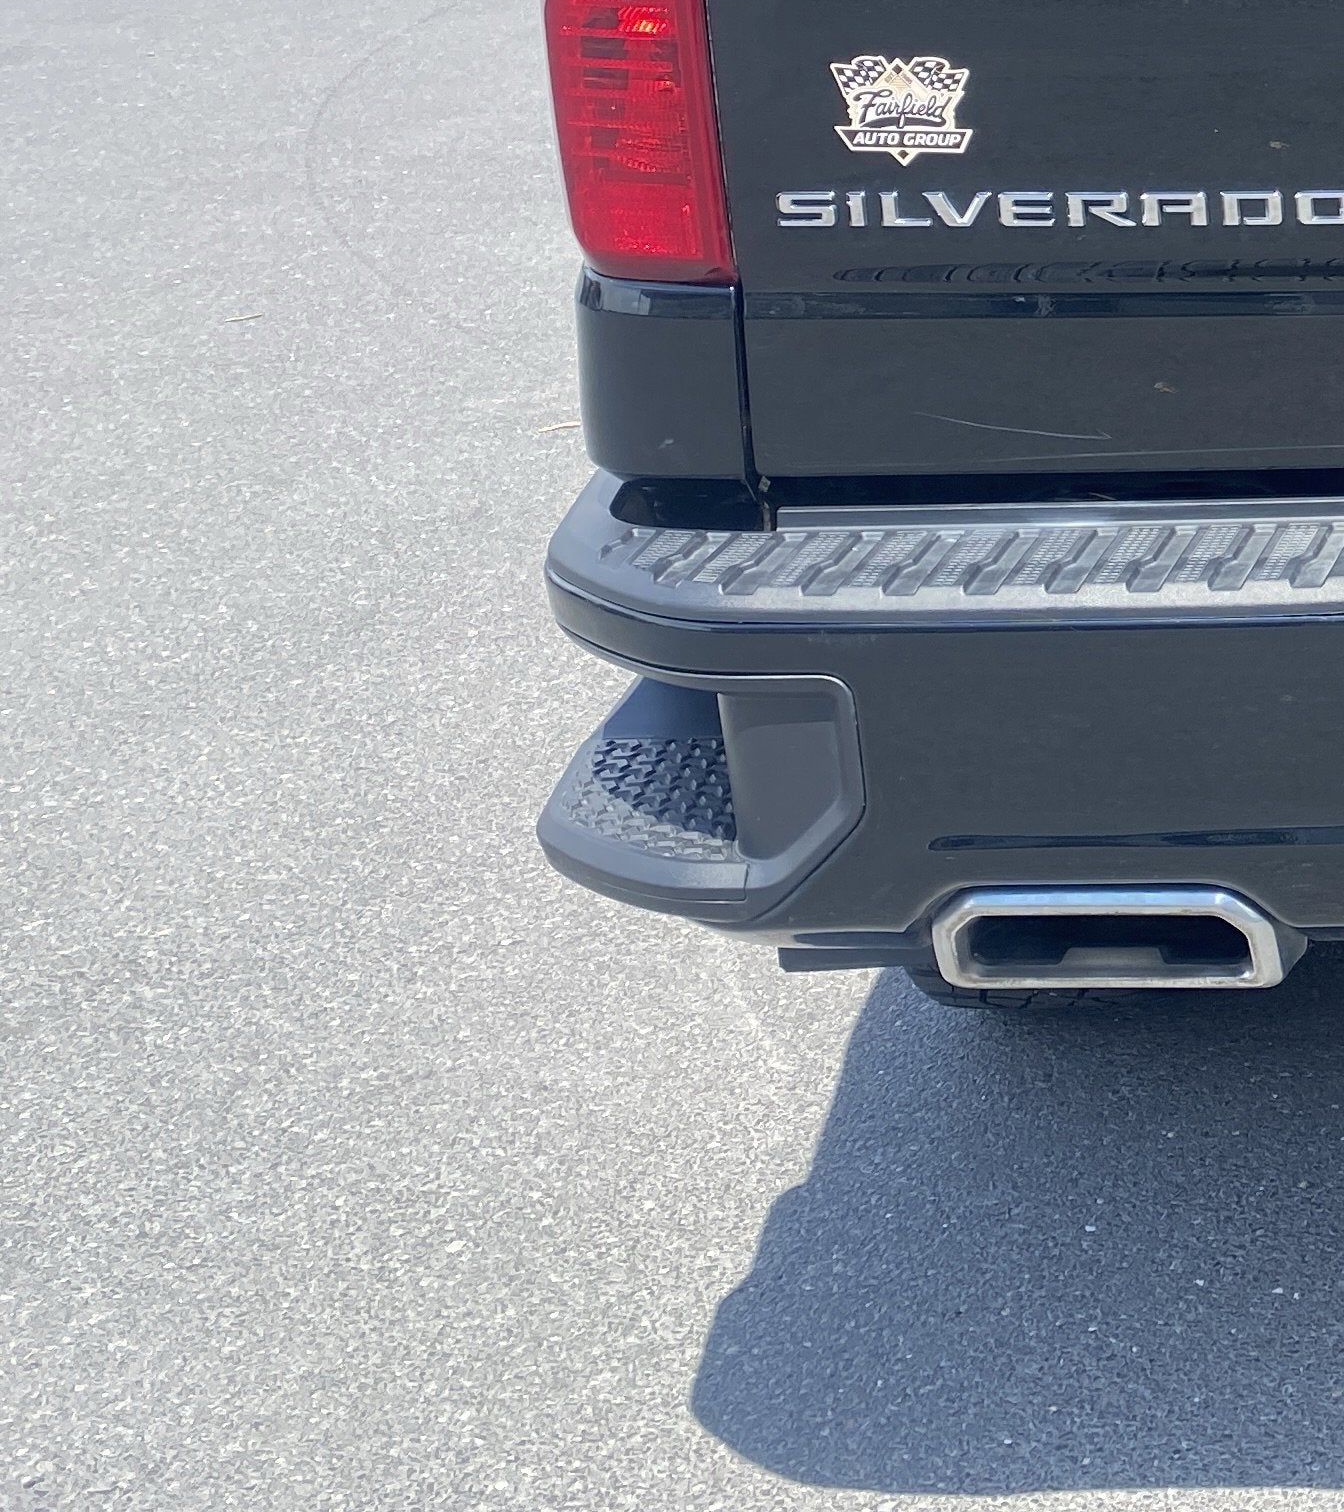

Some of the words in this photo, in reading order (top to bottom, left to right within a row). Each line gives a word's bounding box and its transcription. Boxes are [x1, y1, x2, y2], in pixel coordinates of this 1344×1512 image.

[852, 88, 952, 129] Fairfield
[852, 131, 901, 146] AUTO
[903, 131, 962, 147] GROUP
